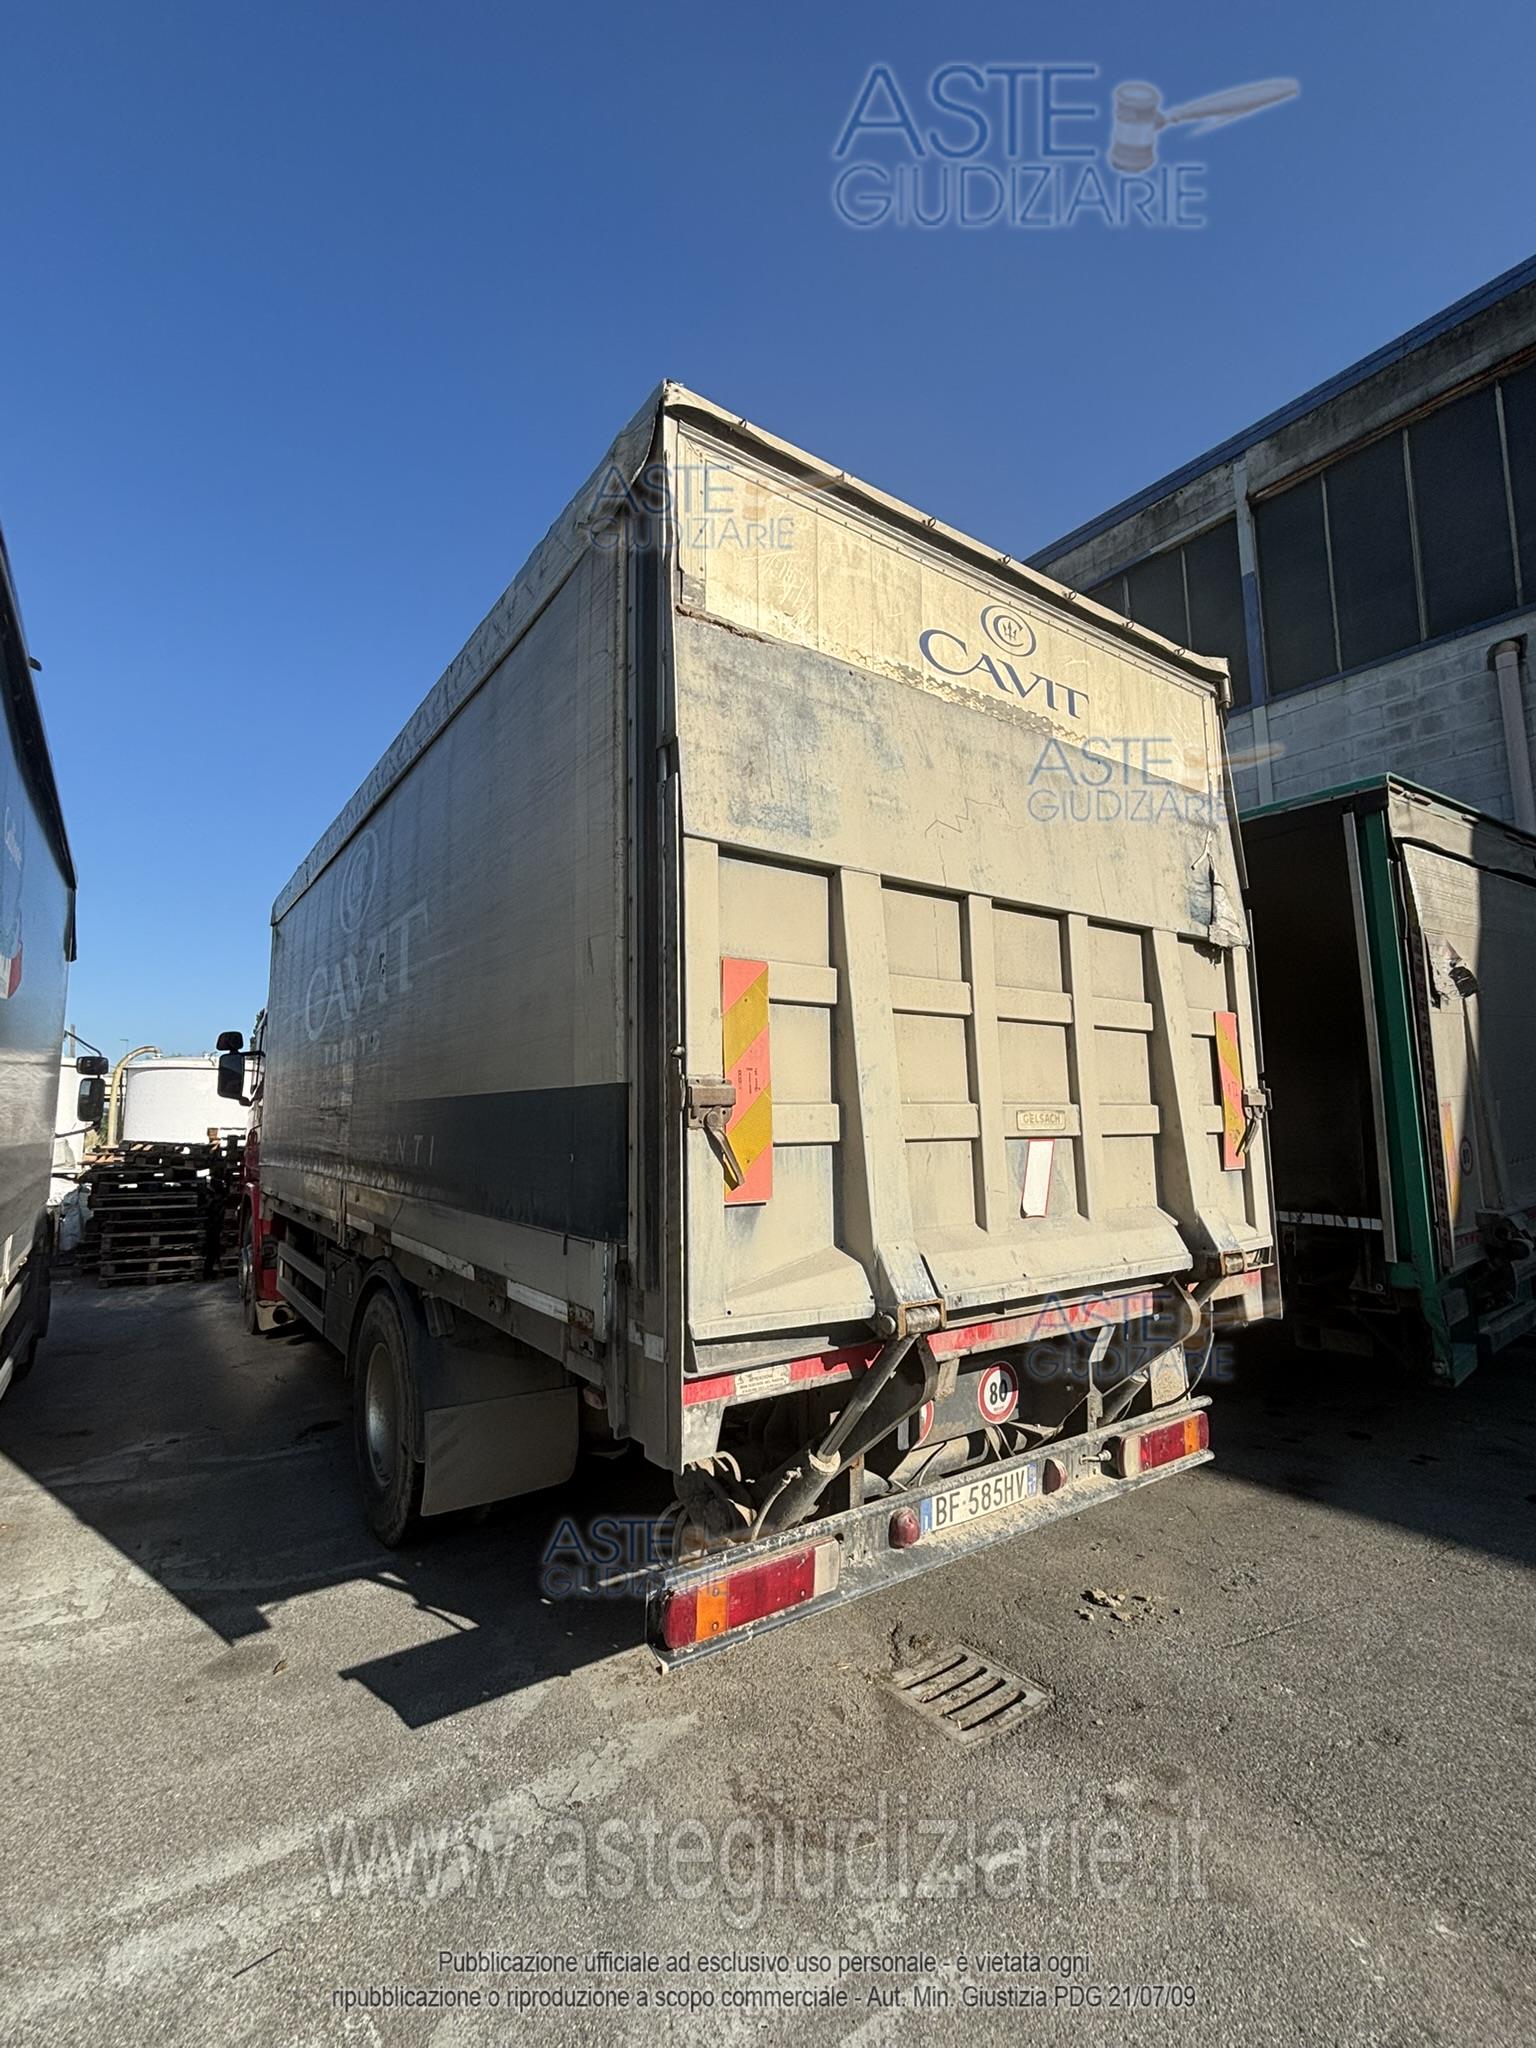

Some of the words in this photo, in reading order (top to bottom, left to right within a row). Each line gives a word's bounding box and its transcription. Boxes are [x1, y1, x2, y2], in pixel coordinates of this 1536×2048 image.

[918, 628, 1090, 720] CAVIT
[305, 899, 429, 1041] CAVIT
[990, 1378, 1008, 1406] 80
[936, 1491, 961, 1527] BF
[968, 1469, 1026, 1516] 585HV
